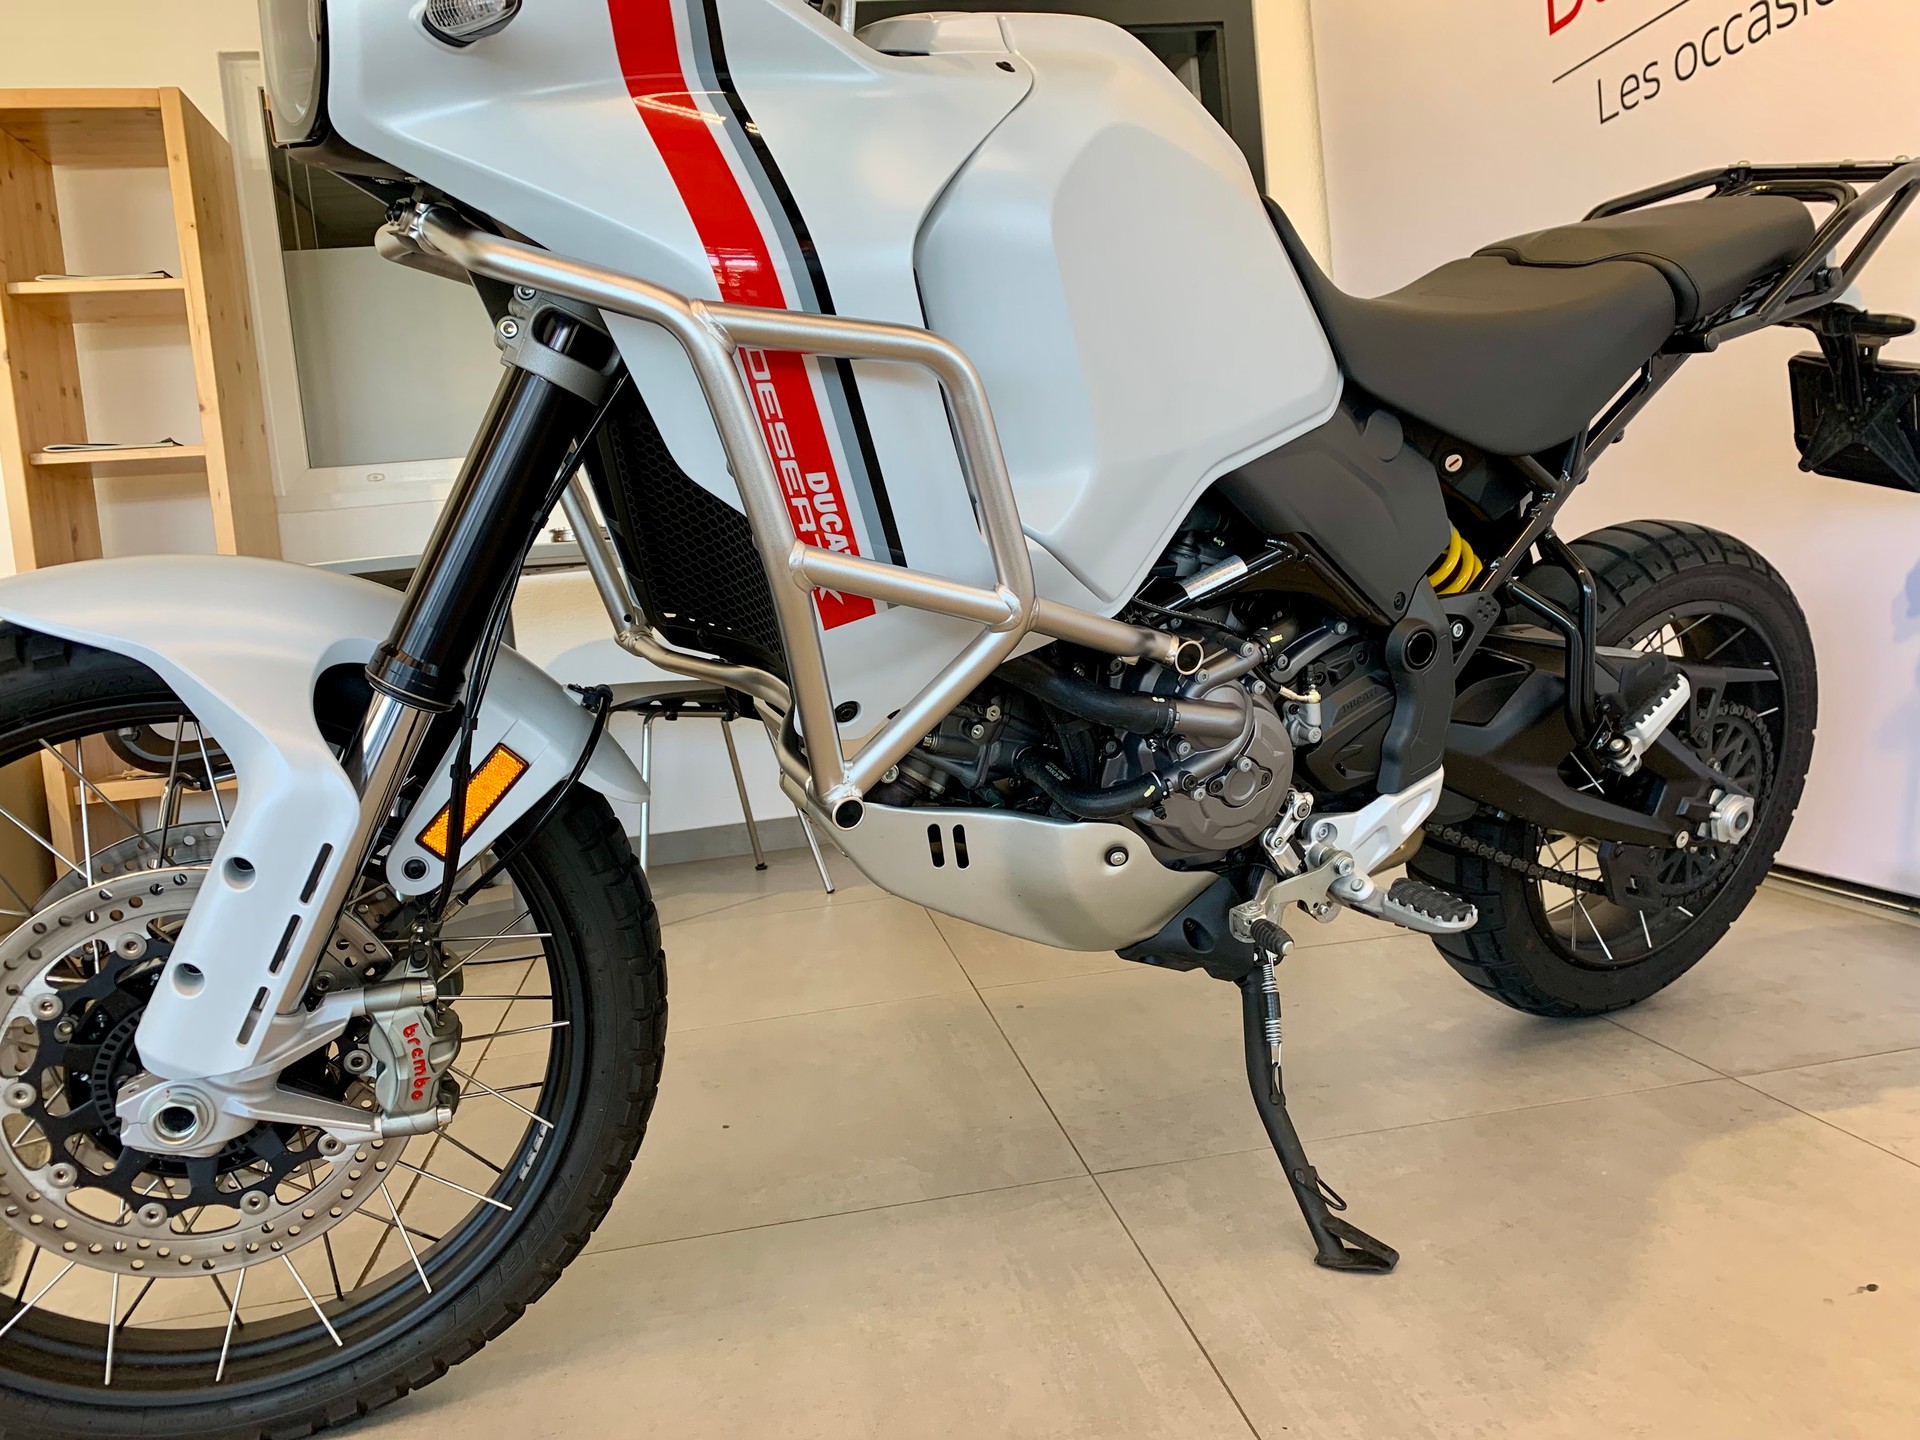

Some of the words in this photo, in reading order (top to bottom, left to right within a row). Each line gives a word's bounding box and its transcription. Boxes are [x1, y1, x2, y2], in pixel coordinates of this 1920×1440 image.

[1598, 61, 1661, 124] Les
[1674, 0, 1834, 81] occas
[805, 471, 854, 556] DUCA
[403, 1023, 431, 1101] brembo
[449, 1176, 573, 1328] PIRELLI
